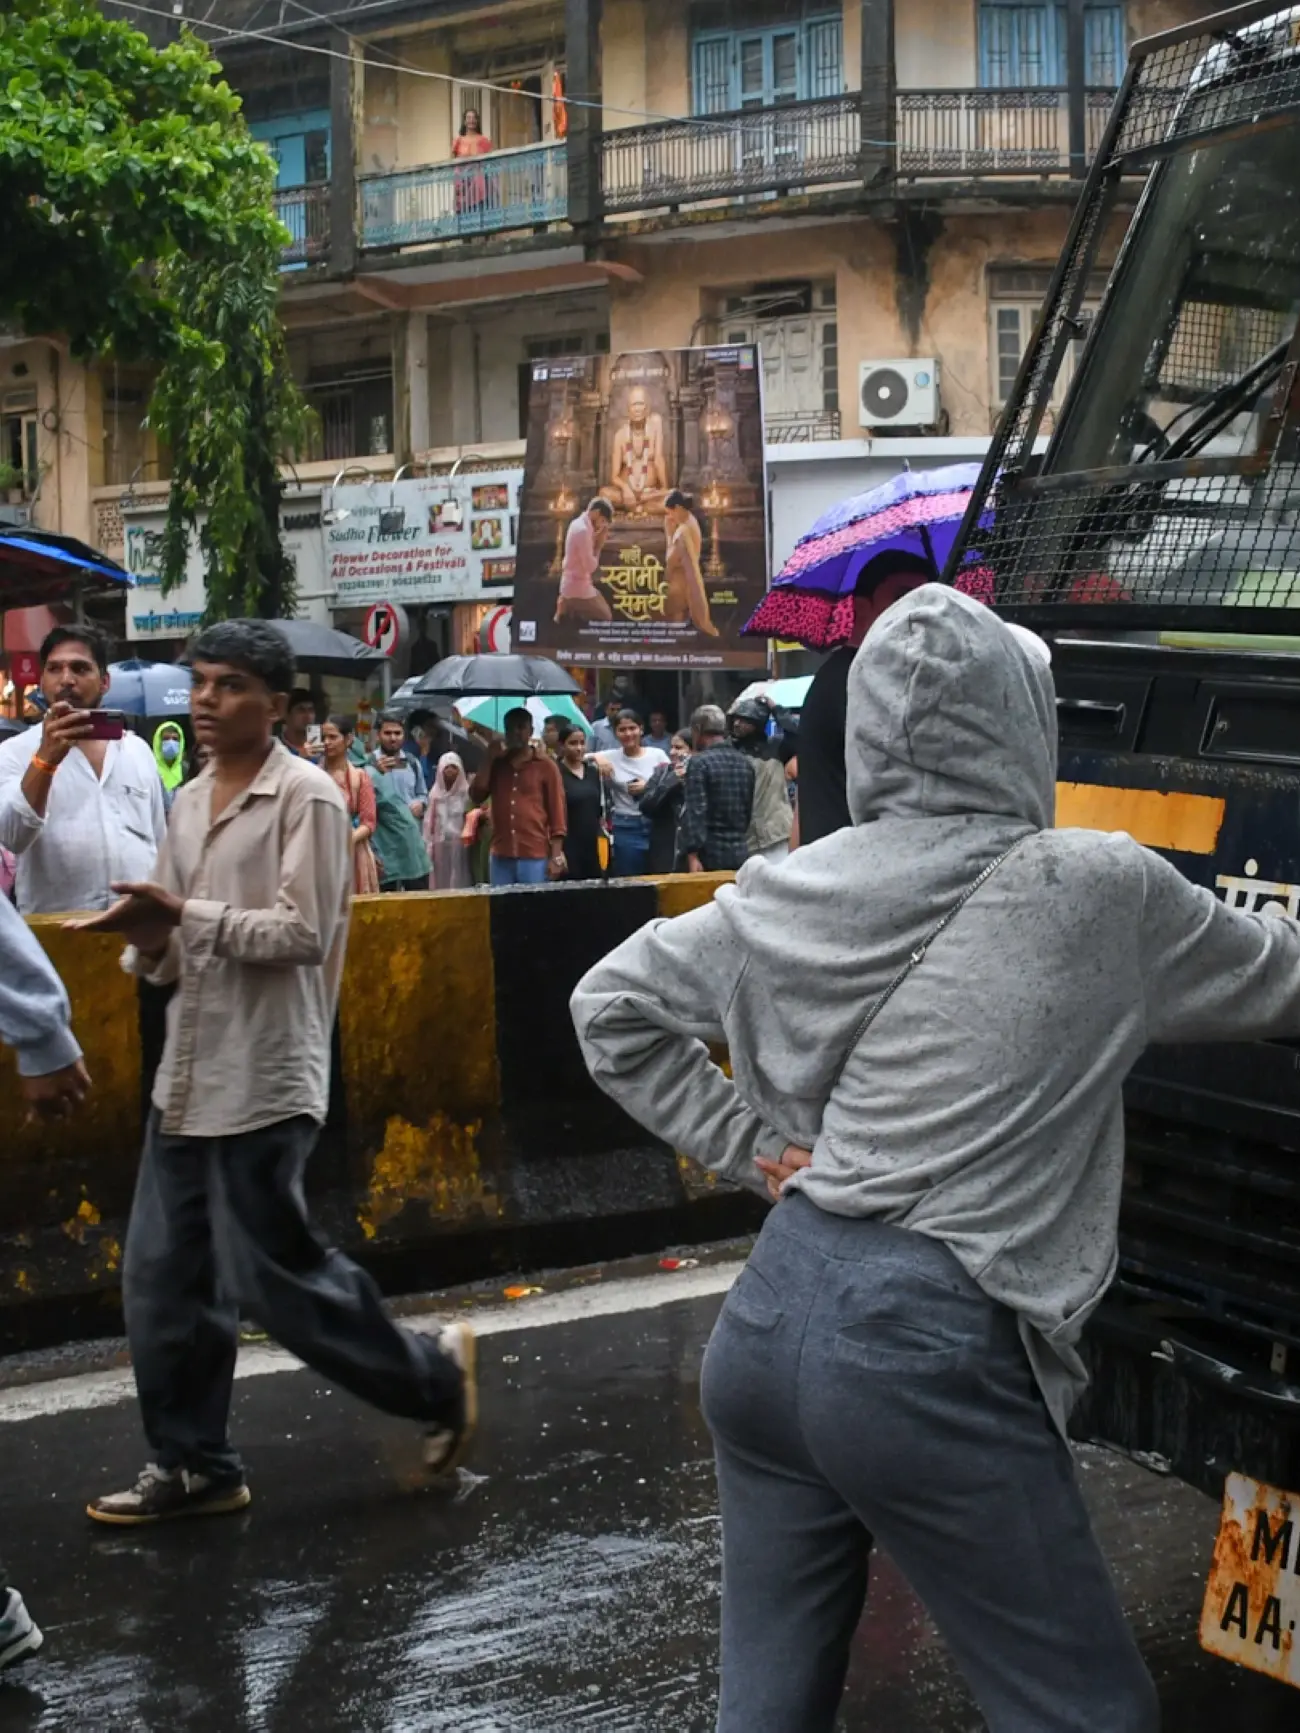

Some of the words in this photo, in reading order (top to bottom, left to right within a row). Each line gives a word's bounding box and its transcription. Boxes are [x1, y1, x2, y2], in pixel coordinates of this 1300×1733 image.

[331, 564, 346, 578] All
[348, 560, 404, 577] Occasions
[406, 559, 413, 572] &
[415, 556, 466, 572] Festivals
[332, 552, 369, 565] Flower
[371, 547, 432, 562] Decoration
[434, 544, 452, 558] for
[600, 554, 664, 594] स्वामी
[613, 581, 668, 620] समर्थ
